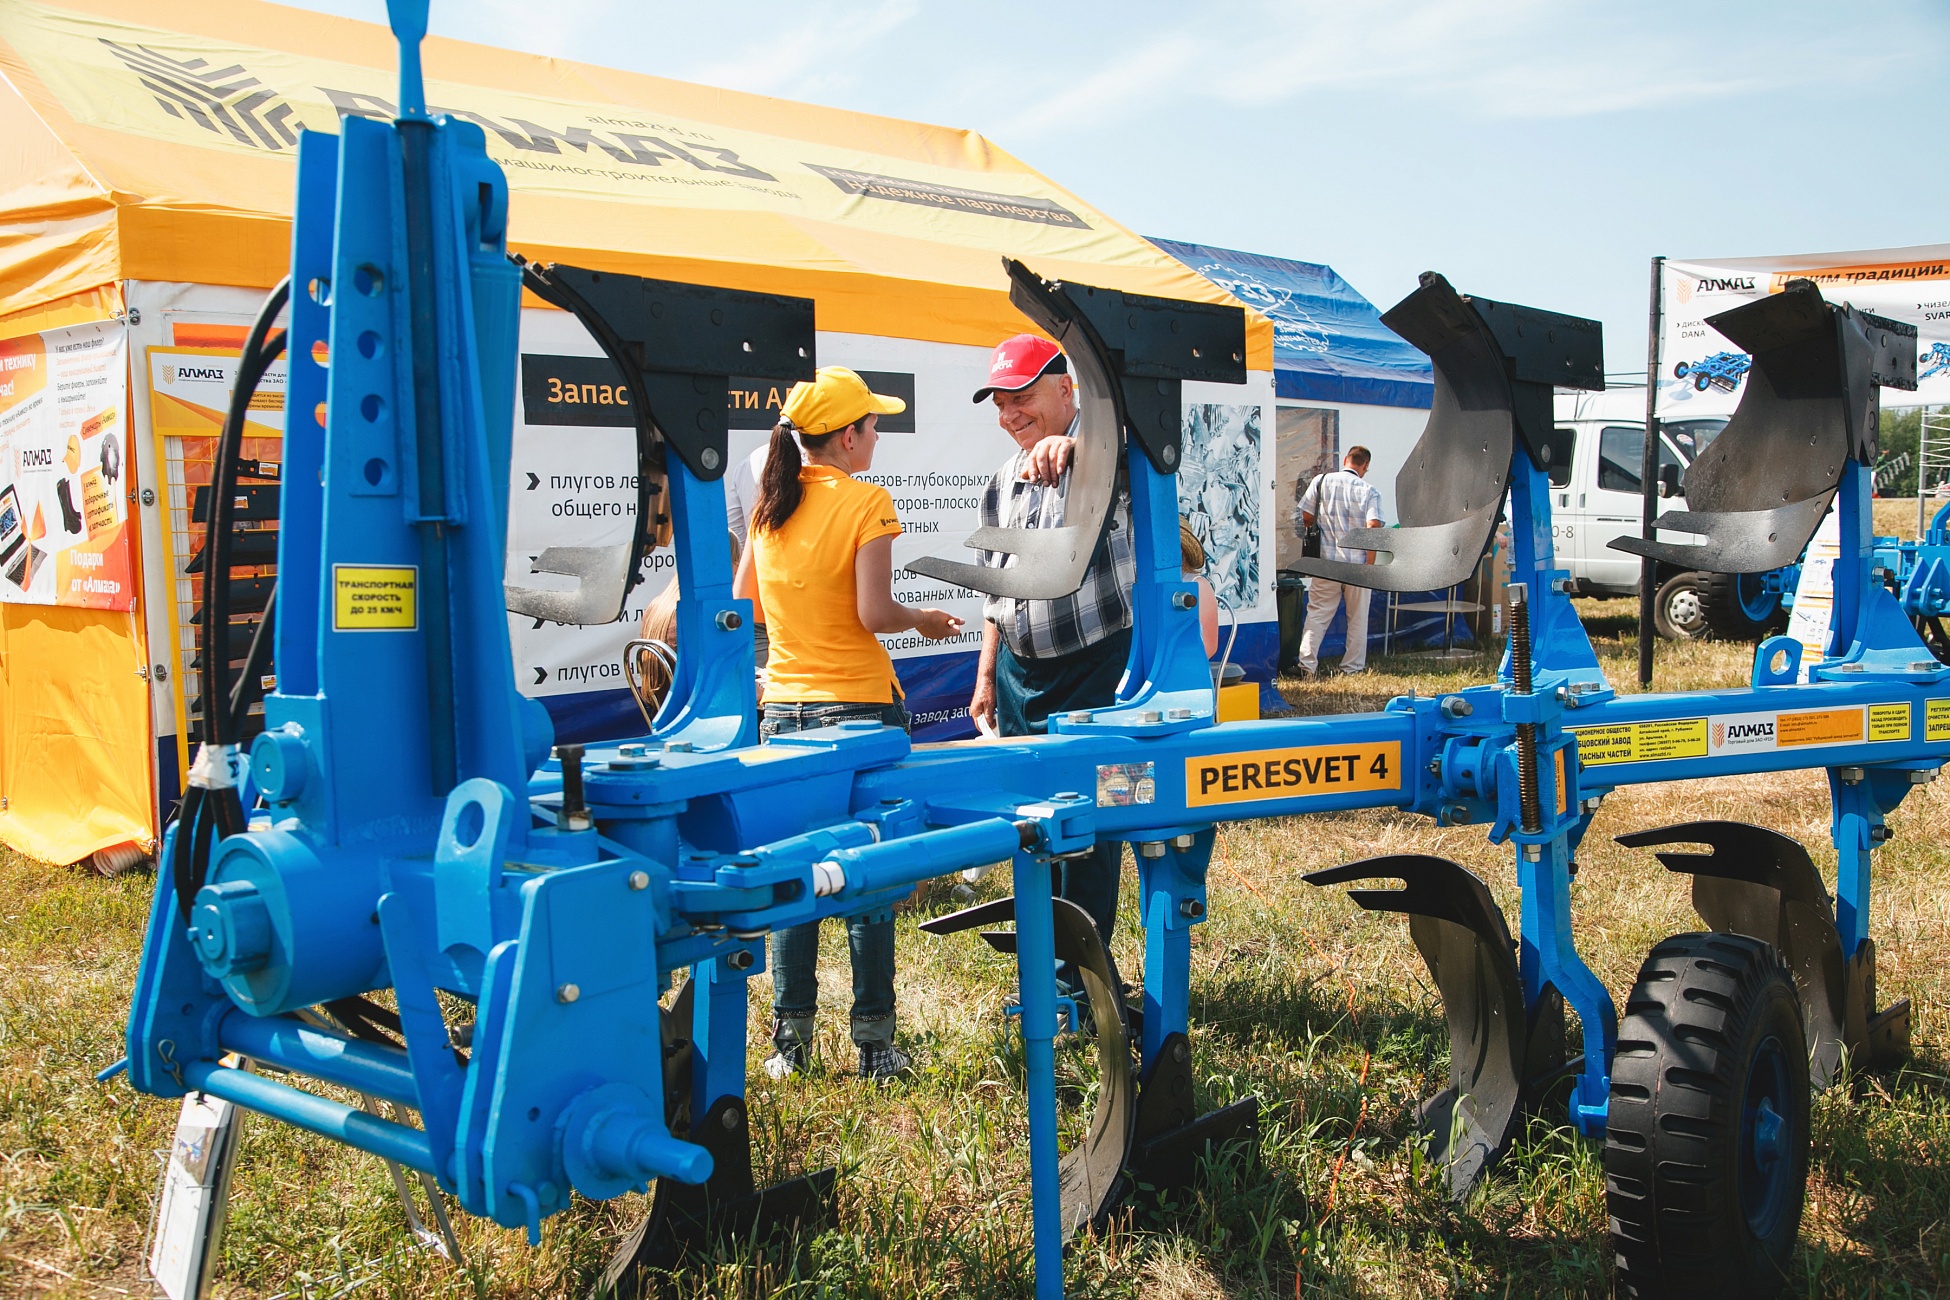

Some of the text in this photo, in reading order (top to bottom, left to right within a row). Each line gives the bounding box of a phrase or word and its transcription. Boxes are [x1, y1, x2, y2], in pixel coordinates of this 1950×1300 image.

[494, 156, 735, 188] машиностроительные
[843, 179, 1074, 224] Надежное партнерство
[1776, 263, 1949, 287] Цим традиции.
[1696, 276, 1756, 293] АЛМАЗ
[1681, 330, 1706, 339] DANA
[4, 353, 37, 371] технику
[178, 367, 225, 380] АЛМАЗ
[547, 377, 629, 406] Запас
[22, 448, 52, 467] АЛМАЗ
[550, 475, 615, 493] плугов
[551, 498, 622, 519] общего
[71, 578, 82, 592] от
[338, 580, 414, 590] ТРАНСПОРТНАЯ
[351, 593, 402, 602] СКОРОСТЬ
[350, 606, 365, 615] ДО
[366, 606, 378, 615] 25
[557, 662, 621, 683] плугов
[913, 709, 950, 726] завод
[1605, 726, 1632, 735] ОБЩЕСТВО
[1727, 722, 1774, 738] АЛМАЗ
[1611, 736, 1632, 746] ЗАВОД
[1606, 747, 1632, 759] ЧАСТЕЙ
[1200, 752, 1390, 795] PERESVET 4
